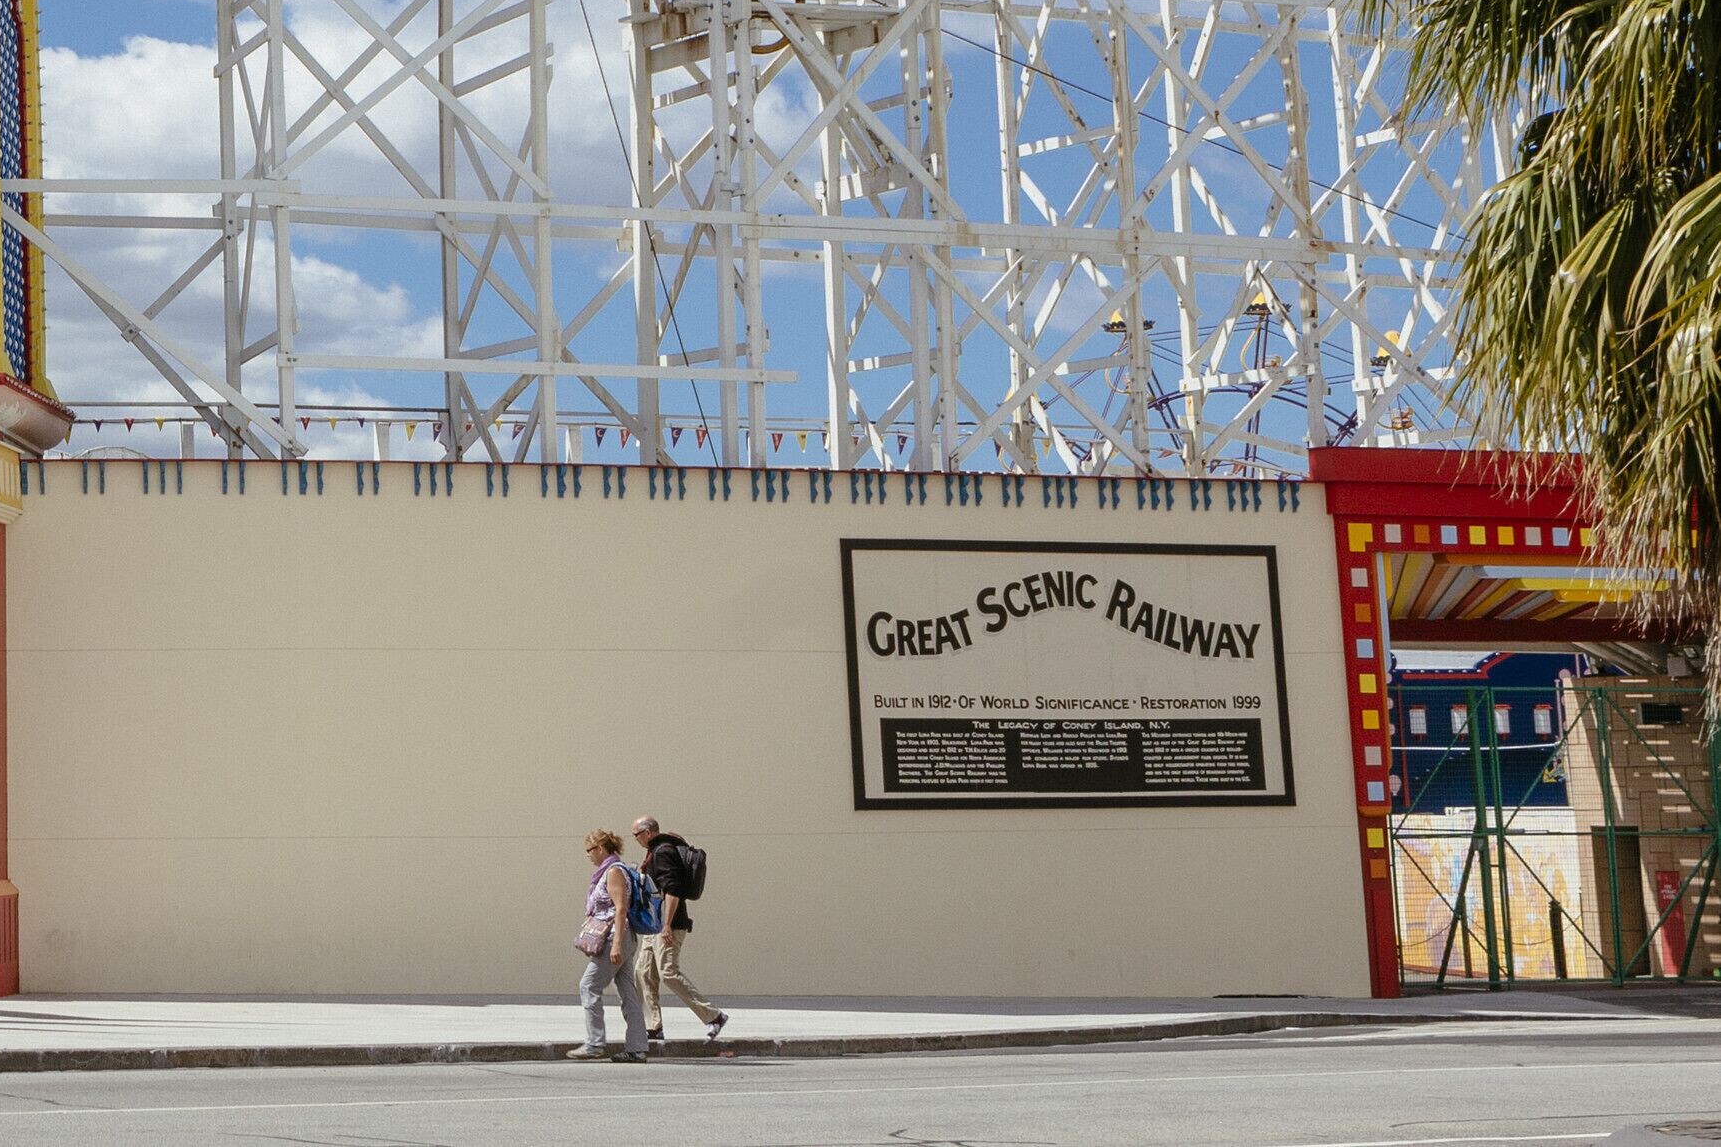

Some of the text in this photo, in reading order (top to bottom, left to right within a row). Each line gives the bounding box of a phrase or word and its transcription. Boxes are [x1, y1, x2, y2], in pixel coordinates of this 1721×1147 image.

[867, 571, 1261, 659] GREAT SCENIC RAILWAY
[874, 695, 908, 709] BUILT
[912, 697, 924, 709] IN
[980, 695, 1029, 709] WORLD
[1035, 696, 1129, 710] SIGNIFICANCE
[1140, 696, 1227, 710] RESTORATION
[1233, 695, 1261, 709] 1999
[972, 721, 990, 729] THE
[998, 721, 1038, 729] LEGACY
[1062, 721, 1097, 729] CONEY
[1149, 721, 1170, 729] N.Y.
